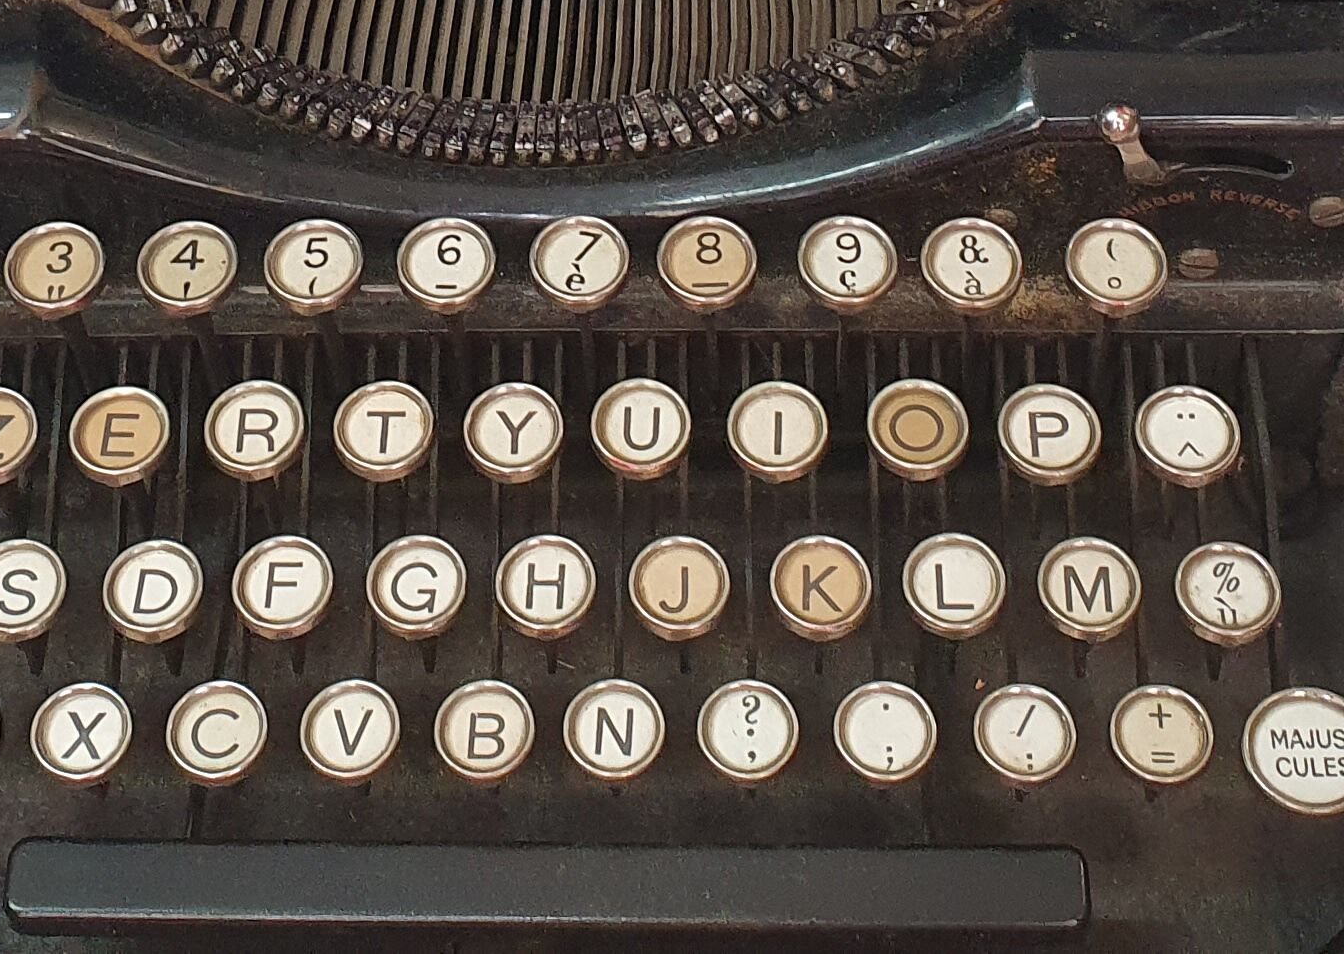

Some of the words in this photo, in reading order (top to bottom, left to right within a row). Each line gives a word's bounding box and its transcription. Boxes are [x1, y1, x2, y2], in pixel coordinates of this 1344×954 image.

[1210, 189, 1301, 221] REVERSE
[47, 242, 72, 273] 3
[171, 240, 204, 270] 4
[304, 238, 328, 268] 5
[438, 235, 461, 265] 6
[575, 231, 602, 261] 7
[696, 233, 722, 264] 8
[837, 233, 861, 263] 9
[960, 235, 988, 263] &
[566, 263, 585, 291] è
[840, 271, 856, 296] ç
[965, 271, 984, 295] à
[100, 413, 139, 457] E
[236, 409, 278, 452] R
[367, 412, 406, 453] T
[497, 411, 536, 454] Y
[624, 407, 660, 450] U
[774, 412, 782, 455] I
[889, 405, 944, 452] O
[1029, 412, 1068, 457] P
[133, 569, 177, 614] D
[265, 562, 303, 608] F
[391, 563, 437, 613] G
[526, 563, 565, 609] H
[659, 567, 688, 613] J
[803, 565, 842, 612] K
[935, 564, 974, 609] L
[1064, 566, 1112, 612] M
[1213, 563, 1239, 594] %
[62, 712, 106, 759] X
[191, 709, 239, 758] C
[334, 710, 373, 755] V
[468, 713, 505, 759] B
[595, 707, 633, 756] N
[743, 695, 760, 736] ?
[1149, 704, 1171, 728] +
[1152, 752, 1175, 763] =
